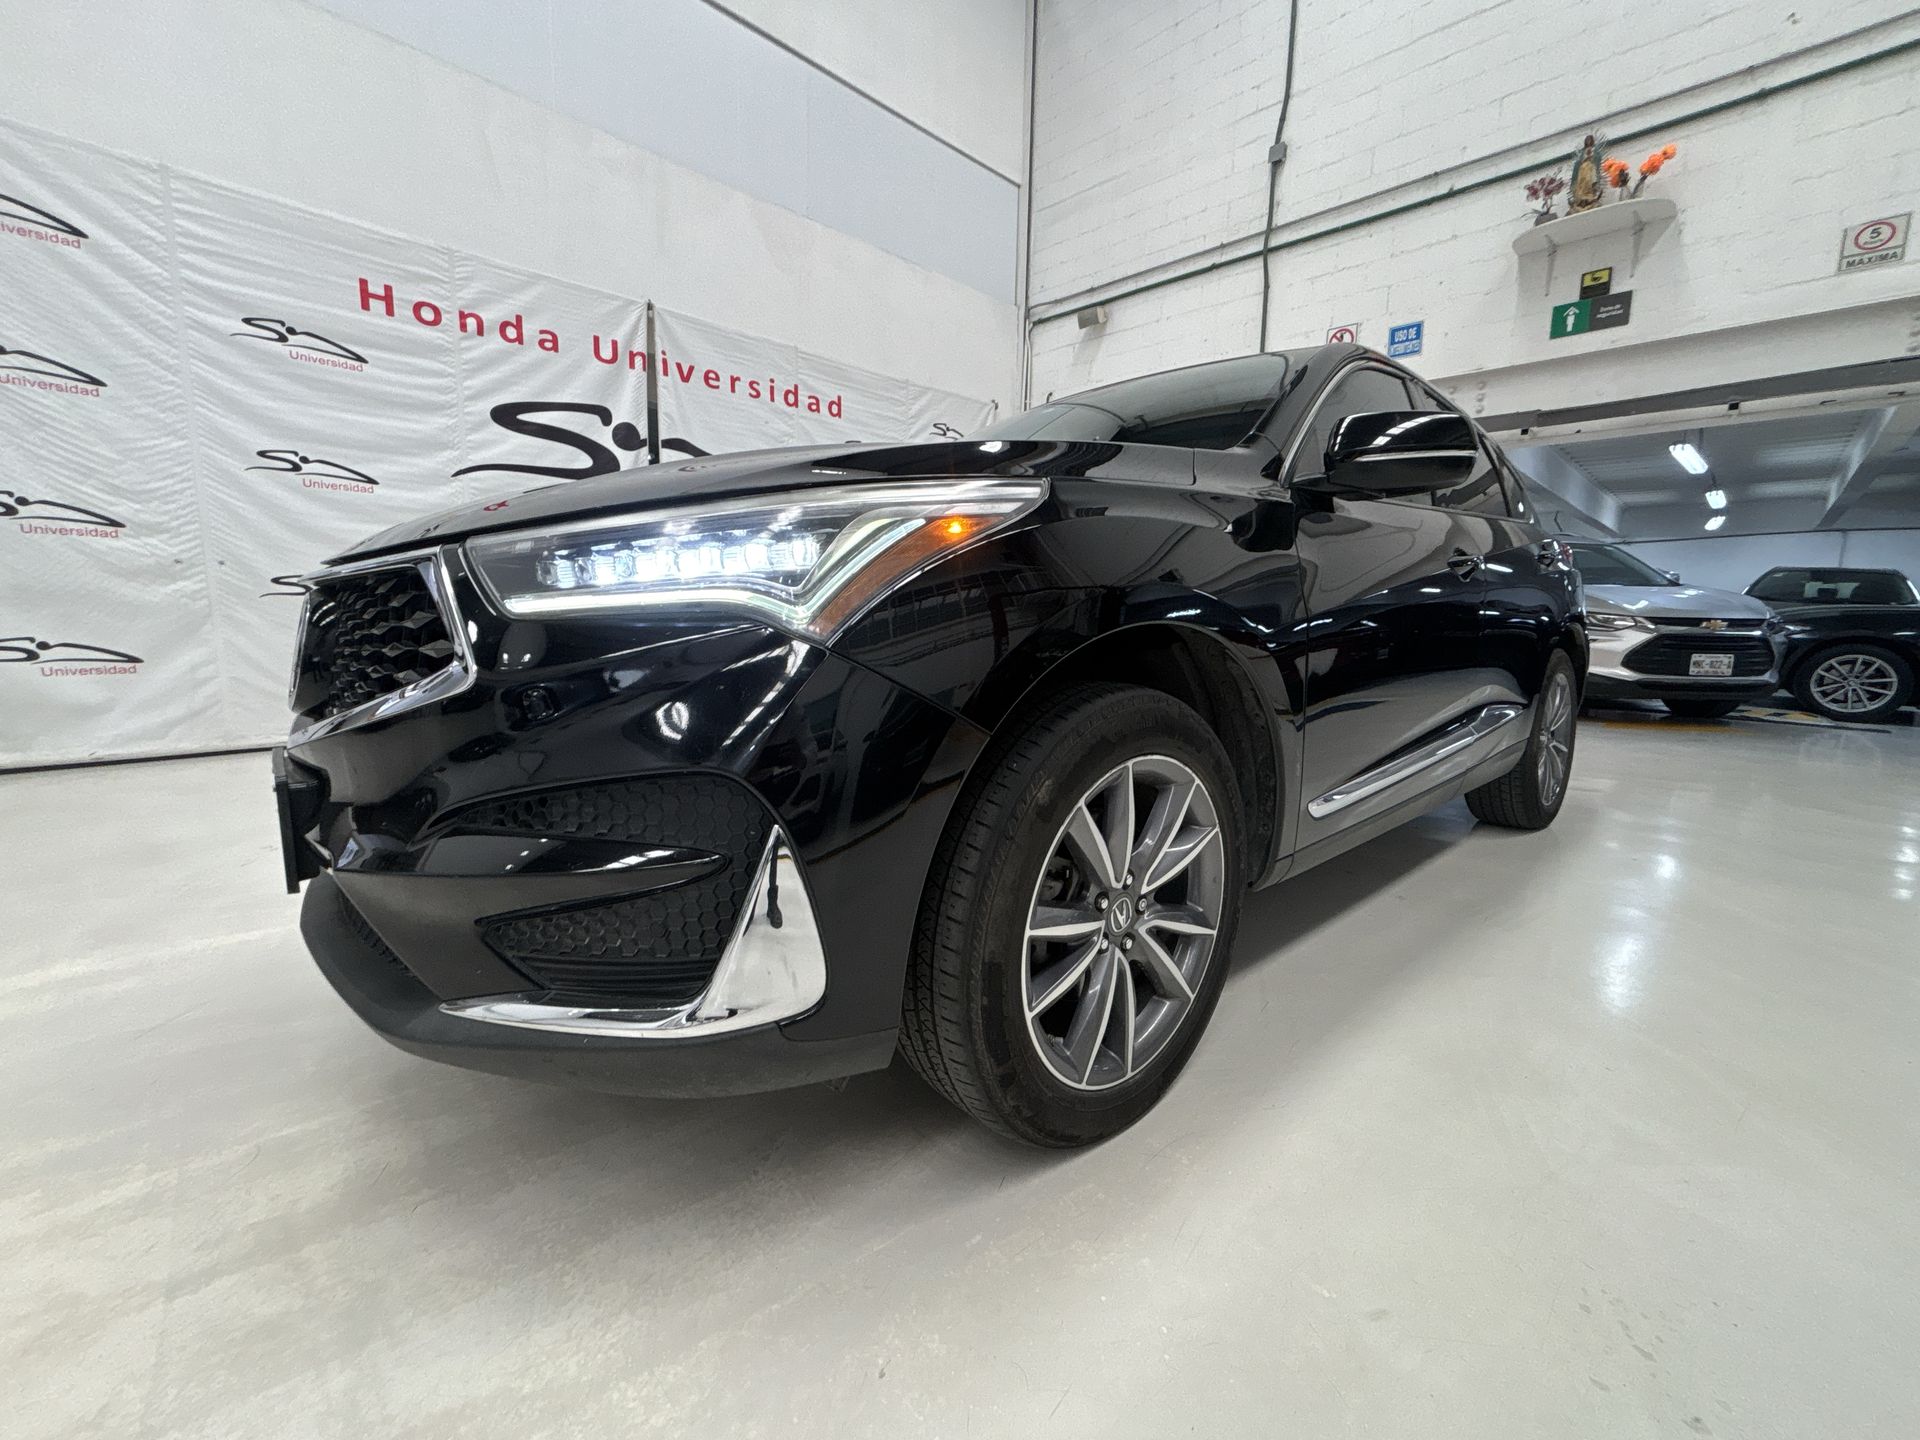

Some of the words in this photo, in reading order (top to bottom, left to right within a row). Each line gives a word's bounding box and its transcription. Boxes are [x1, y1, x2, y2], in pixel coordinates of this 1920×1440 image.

[1869, 226, 1882, 239] 5
[1845, 250, 1899, 269] MAXIMA
[1394, 330, 1408, 343] USO
[1408, 326, 1418, 340] DE
[358, 277, 559, 353] Honda
[593, 334, 843, 419] Universidad
[288, 349, 364, 373] Universidad
[0, 373, 101, 398] Universidad
[302, 478, 375, 494] Universidad
[19, 523, 120, 539] Universidad
[40, 664, 138, 677] Universidad
